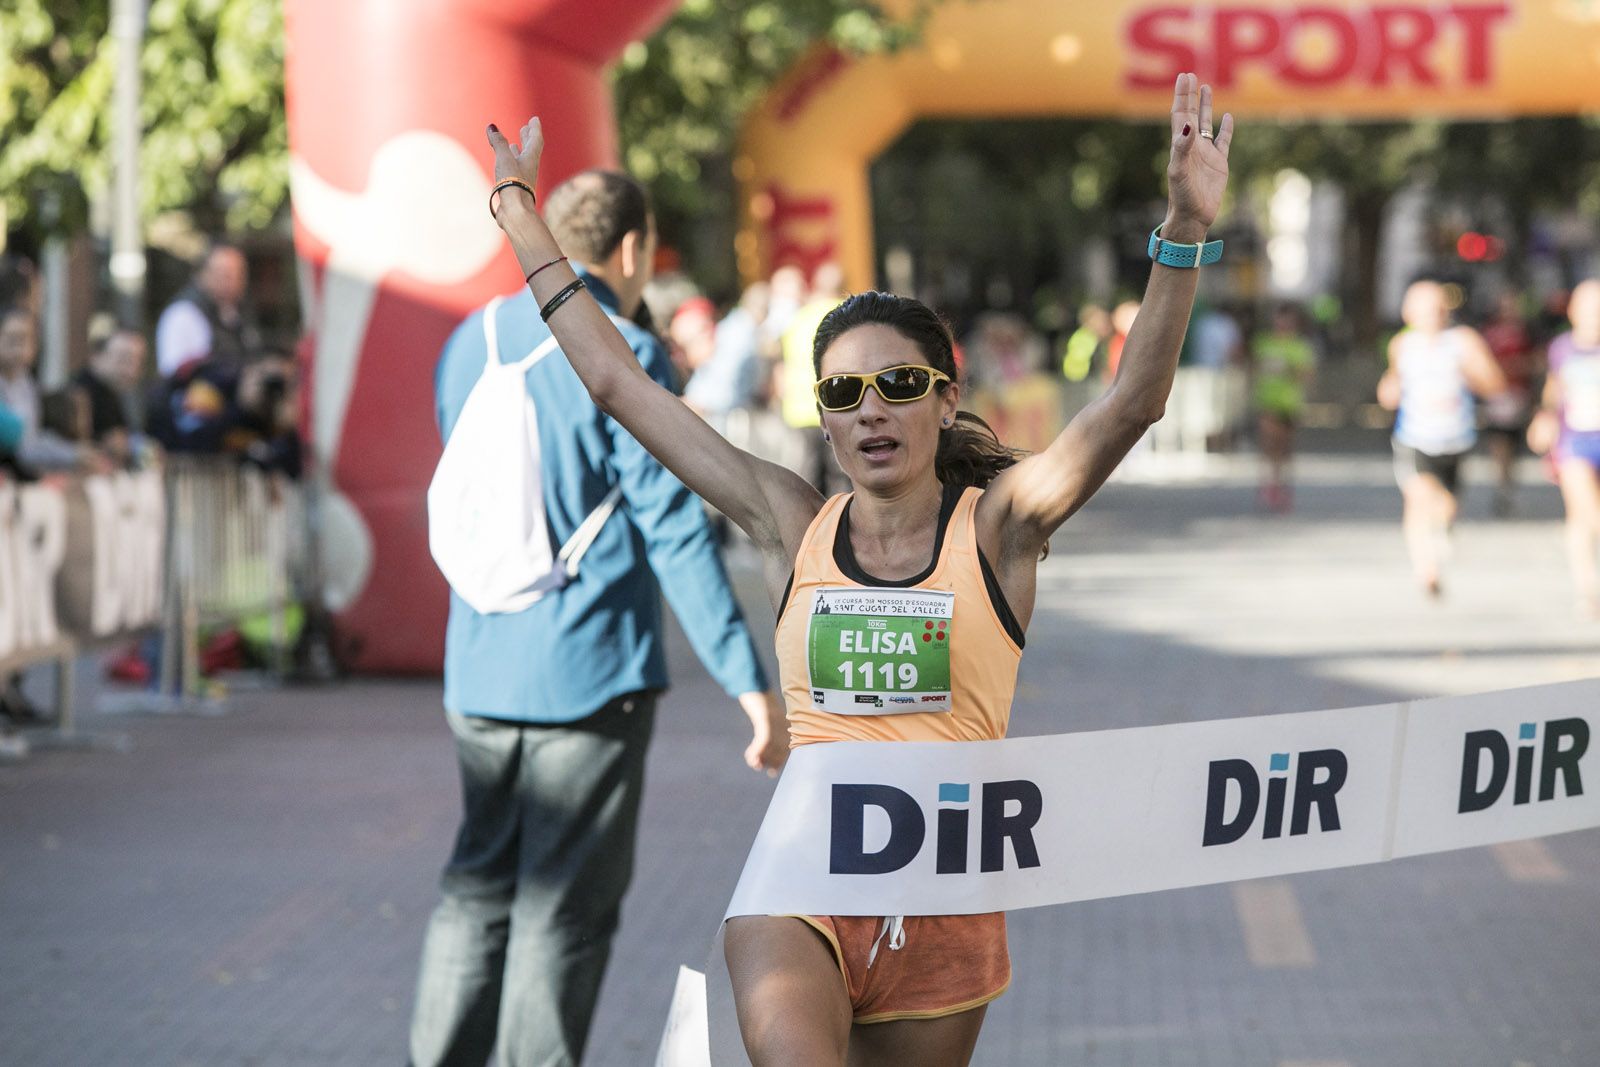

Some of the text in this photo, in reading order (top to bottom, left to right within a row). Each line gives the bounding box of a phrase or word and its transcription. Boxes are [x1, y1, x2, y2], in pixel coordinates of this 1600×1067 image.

[1122, 3, 1512, 90] SPORT
[859, 605, 887, 613] CUGAT
[892, 606, 908, 614] DEL
[839, 630, 917, 655] ELISA
[837, 661, 918, 690] 1119
